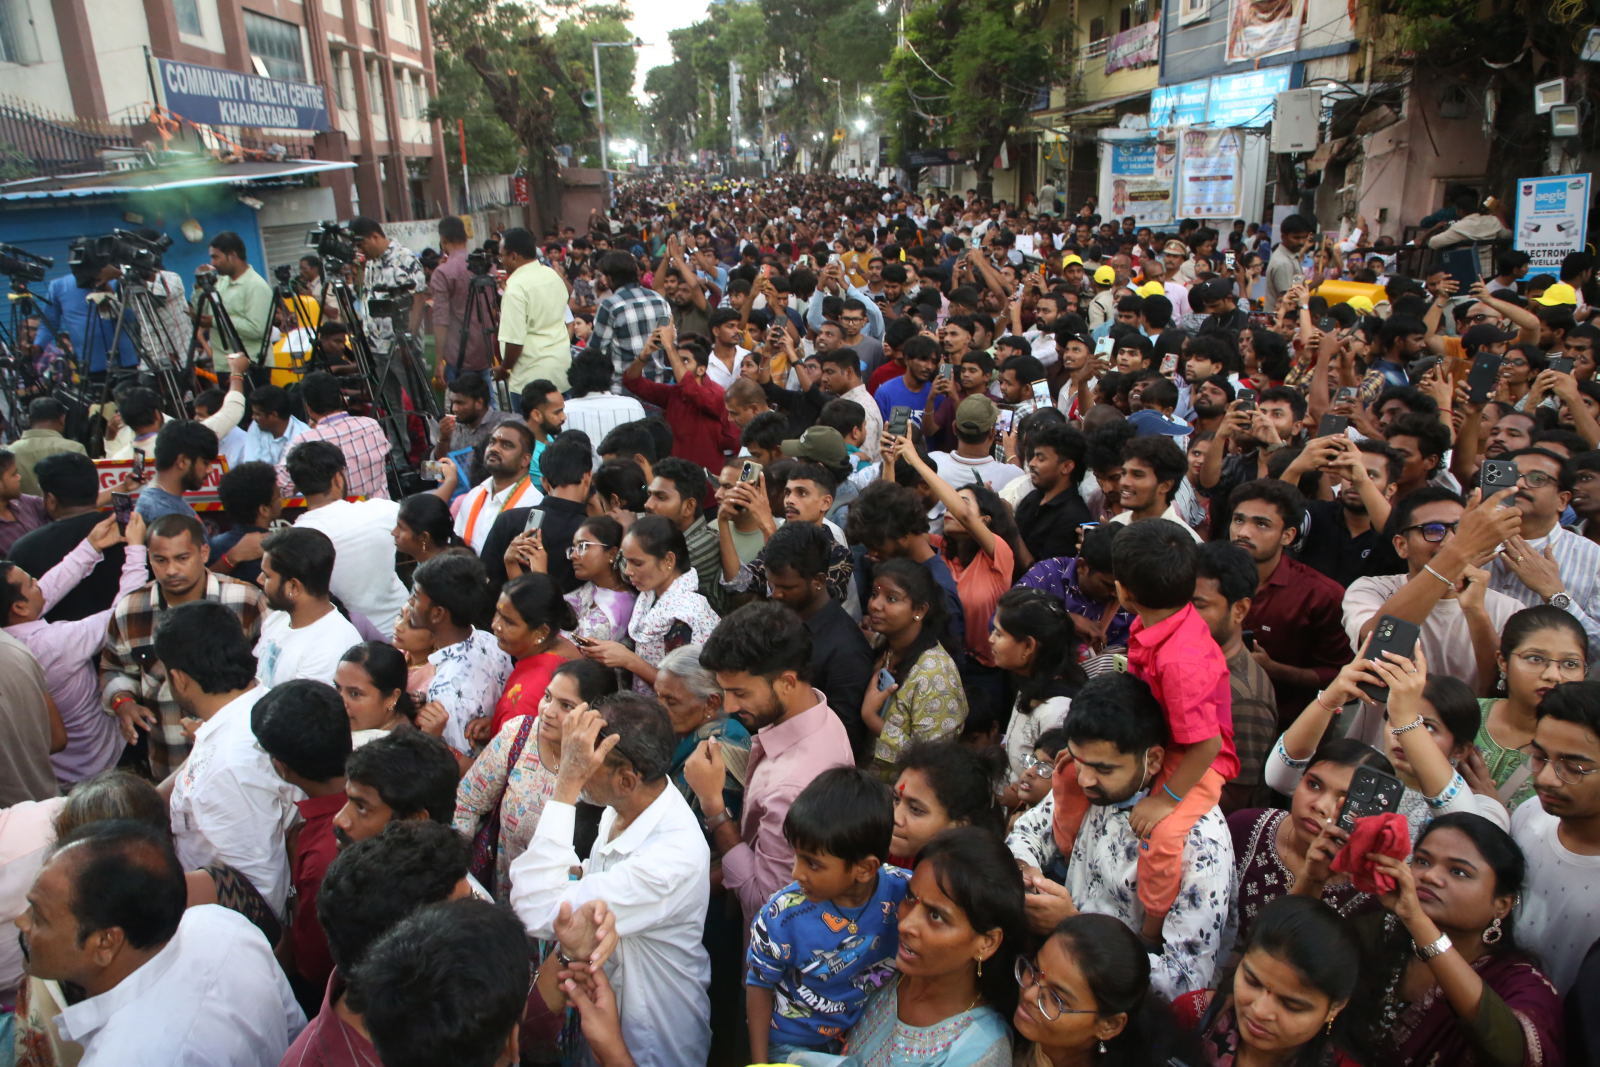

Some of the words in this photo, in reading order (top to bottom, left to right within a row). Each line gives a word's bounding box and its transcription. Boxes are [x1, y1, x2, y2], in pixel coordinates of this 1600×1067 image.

[165, 63, 246, 100] COMMUNITY
[248, 73, 288, 105] HEALTH
[289, 83, 325, 110] CENTRE
[218, 101, 299, 127] KHAIRATABAD
[1536, 189, 1566, 203] aegis
